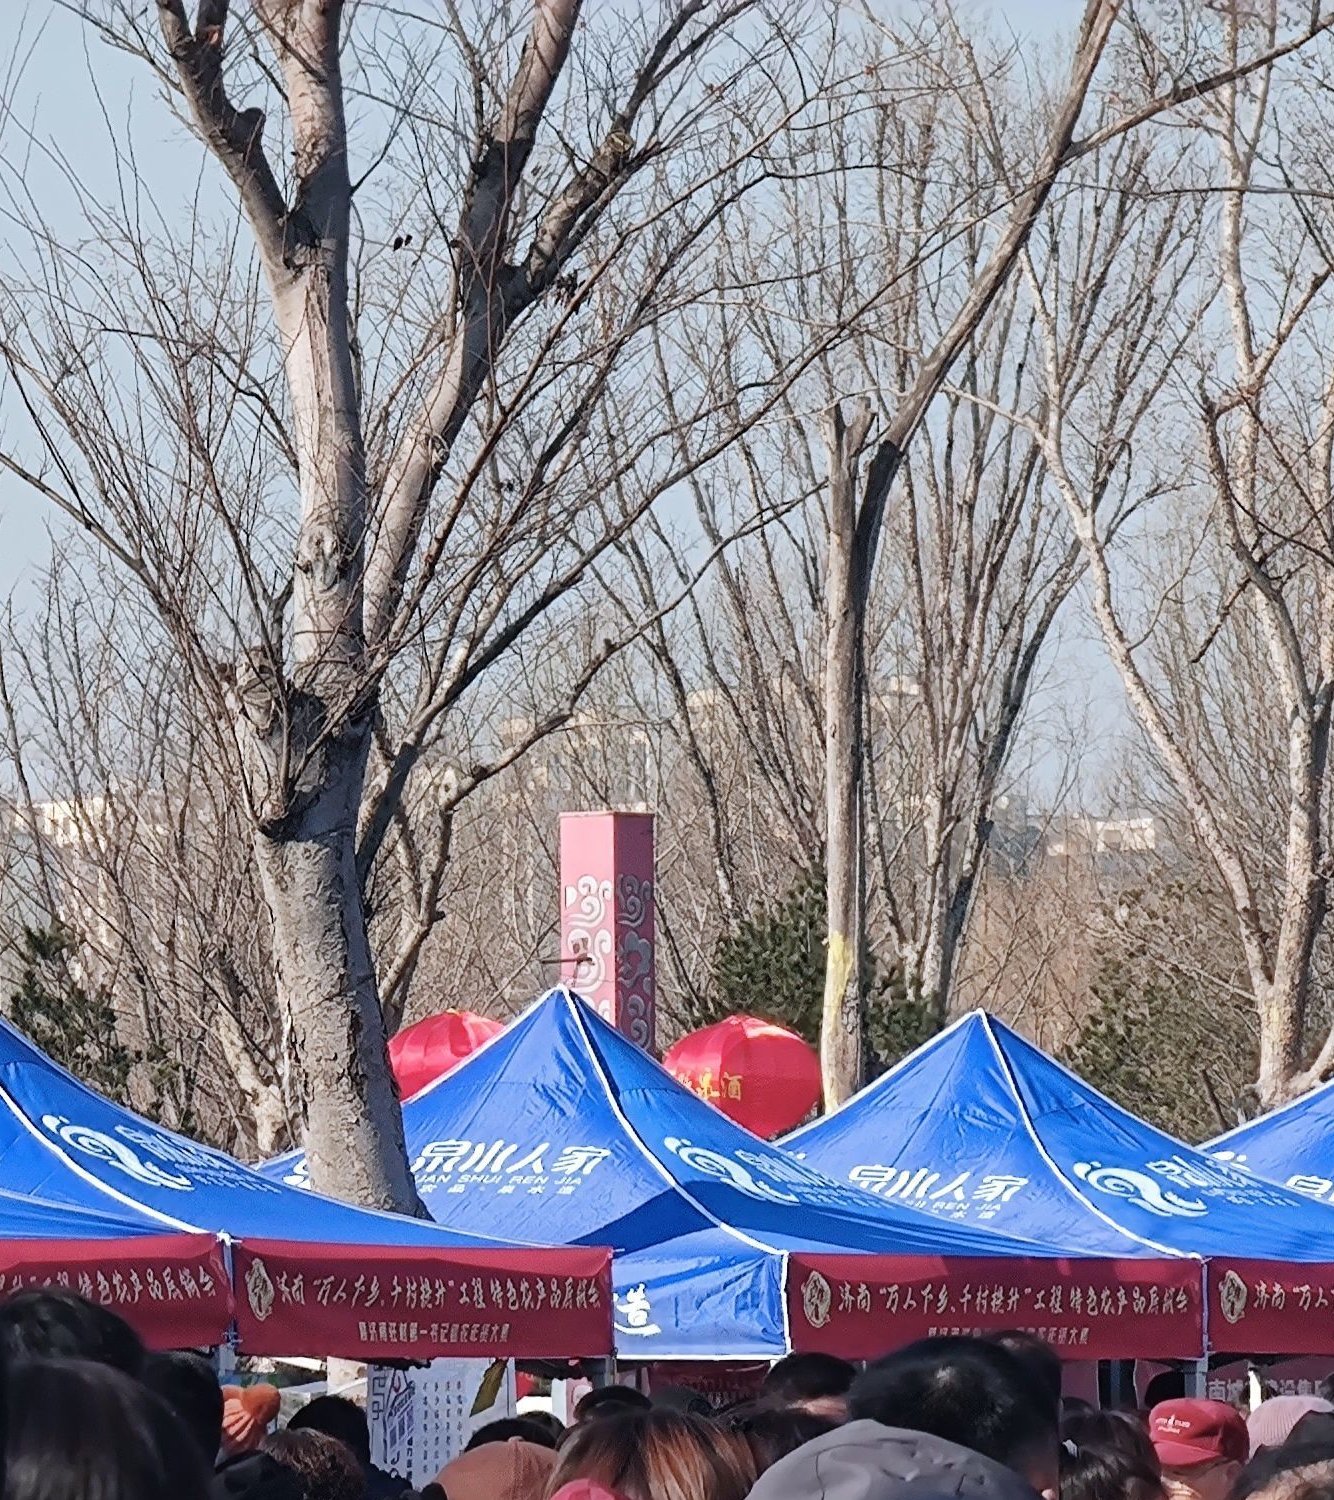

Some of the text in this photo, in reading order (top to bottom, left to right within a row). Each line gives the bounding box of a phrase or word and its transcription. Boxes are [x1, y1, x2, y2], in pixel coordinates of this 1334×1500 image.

[457, 1174, 503, 1185] SHUI
[513, 1175, 549, 1185] REN
[554, 1176, 582, 1186] JIA
